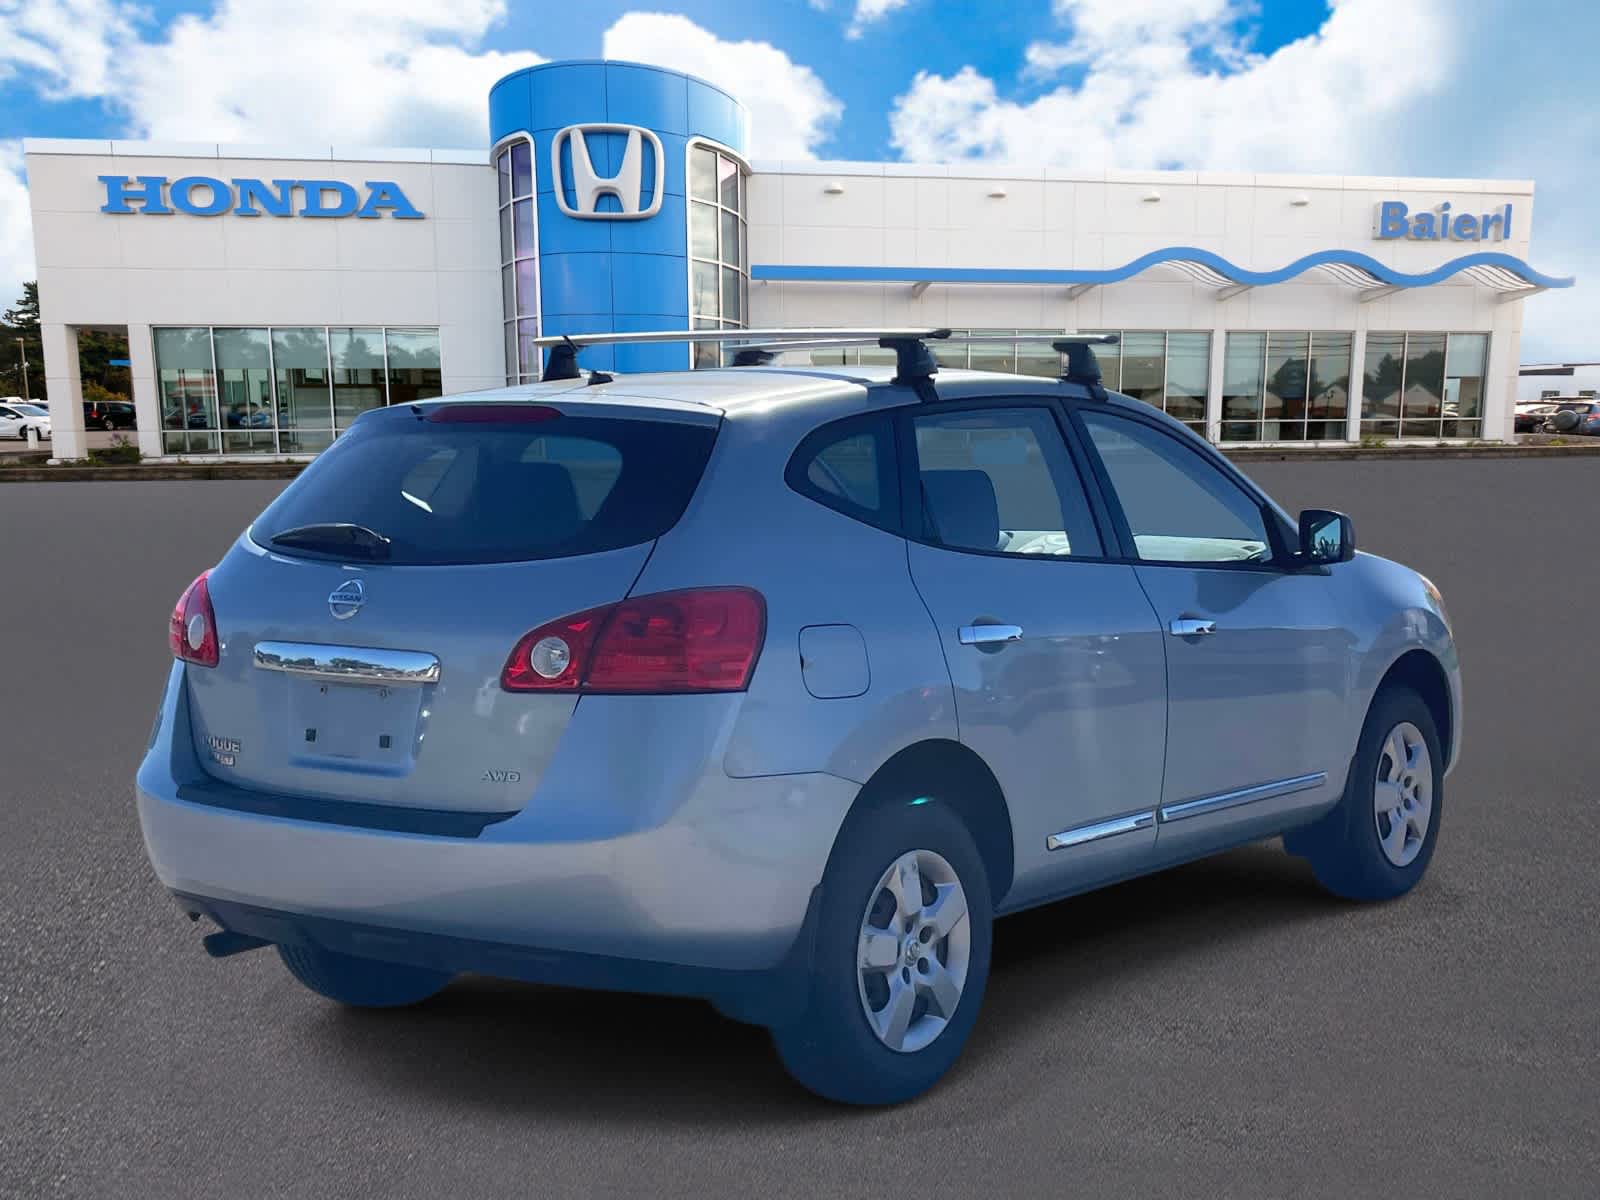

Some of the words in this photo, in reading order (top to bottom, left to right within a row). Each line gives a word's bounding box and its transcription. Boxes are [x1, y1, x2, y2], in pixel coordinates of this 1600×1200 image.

[97, 175, 425, 219] HONDA
[1379, 200, 1513, 240] Baierl
[331, 593, 362, 602] NISSAN
[480, 769, 520, 783] AWD
